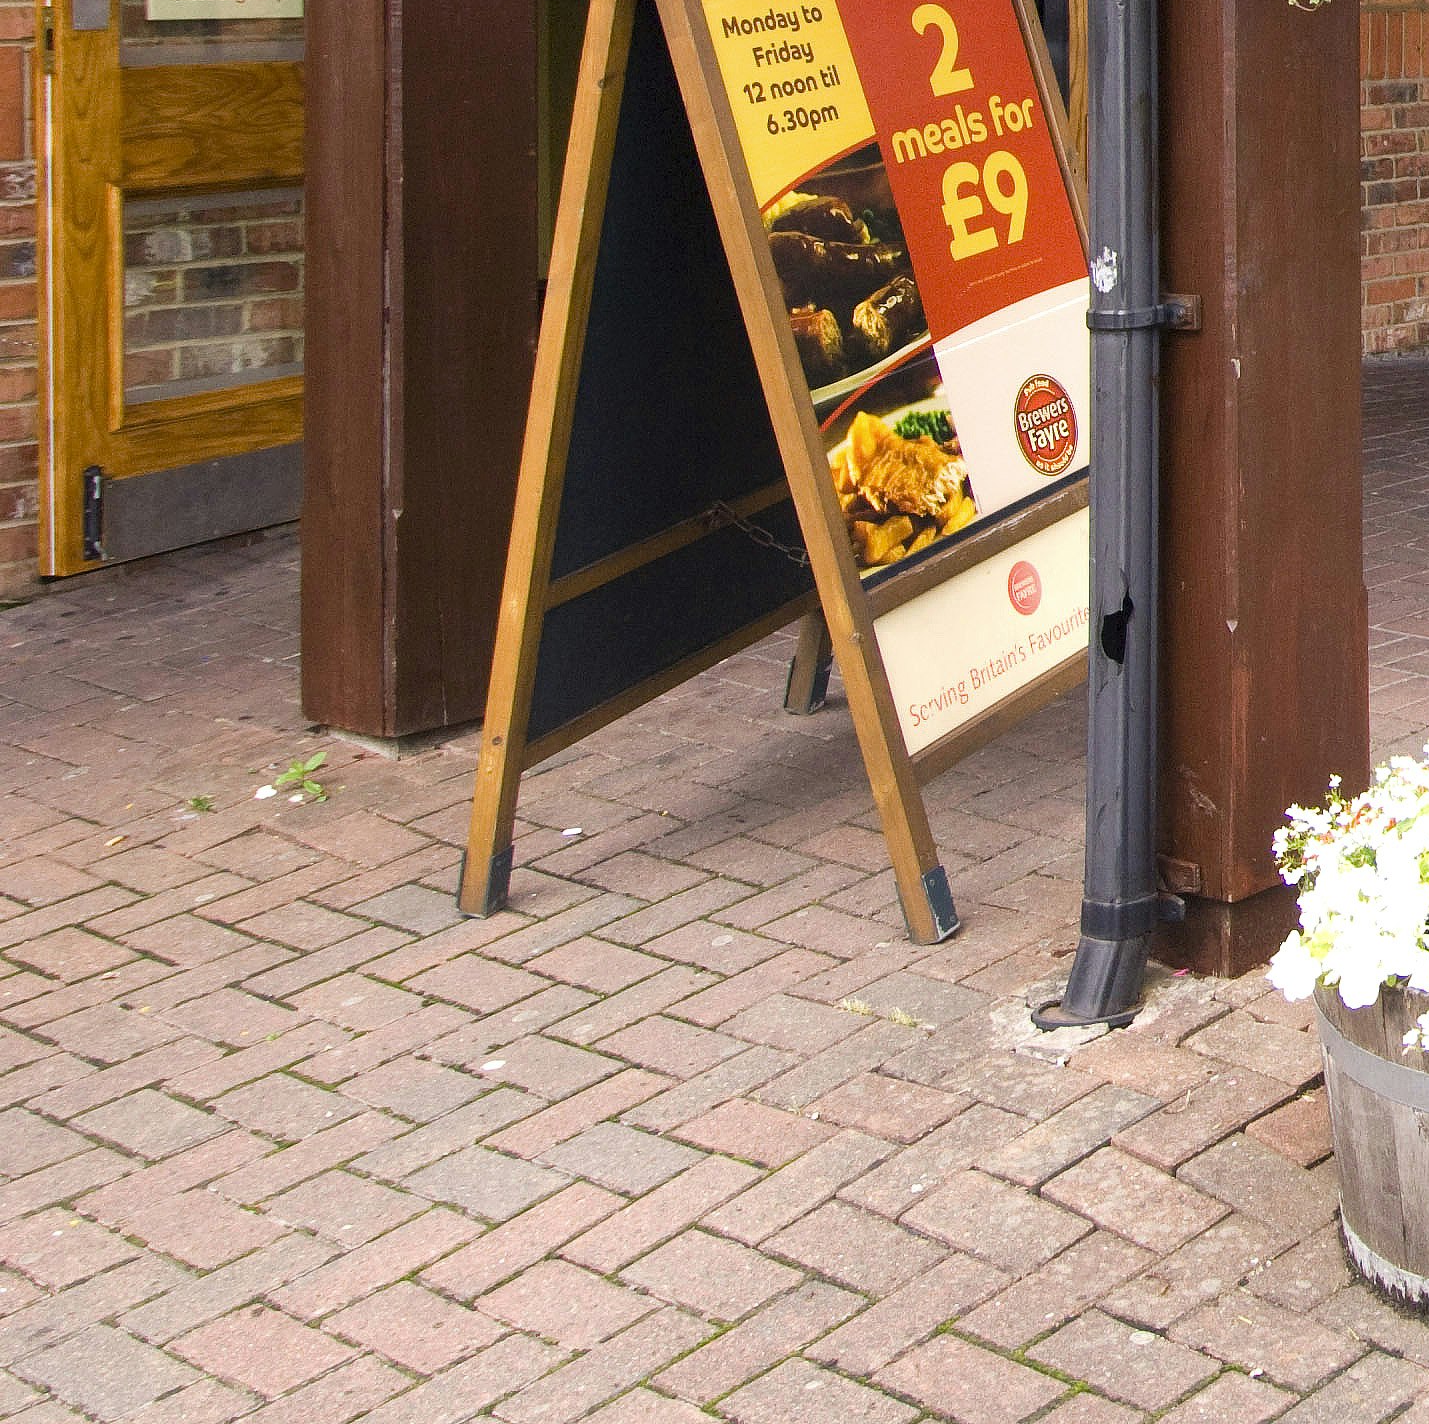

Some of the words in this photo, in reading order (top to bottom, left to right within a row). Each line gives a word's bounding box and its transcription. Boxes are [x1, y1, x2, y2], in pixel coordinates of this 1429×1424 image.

[721, 8, 800, 38] Monday
[801, 5, 823, 24] to
[752, 40, 815, 68] Friday
[911, 3, 975, 97] 2
[743, 81, 767, 105] 12
[770, 75, 818, 100] noon
[819, 64, 841, 88] til
[767, 104, 839, 135] 6.30pm
[891, 103, 988, 164] meals
[988, 95, 1034, 137] for
[941, 150, 1029, 262] £9
[1018, 397, 1069, 432] Brewers
[1027, 419, 1070, 452] Fayre
[909, 681, 970, 727] Serving
[969, 645, 1027, 691] Britain's
